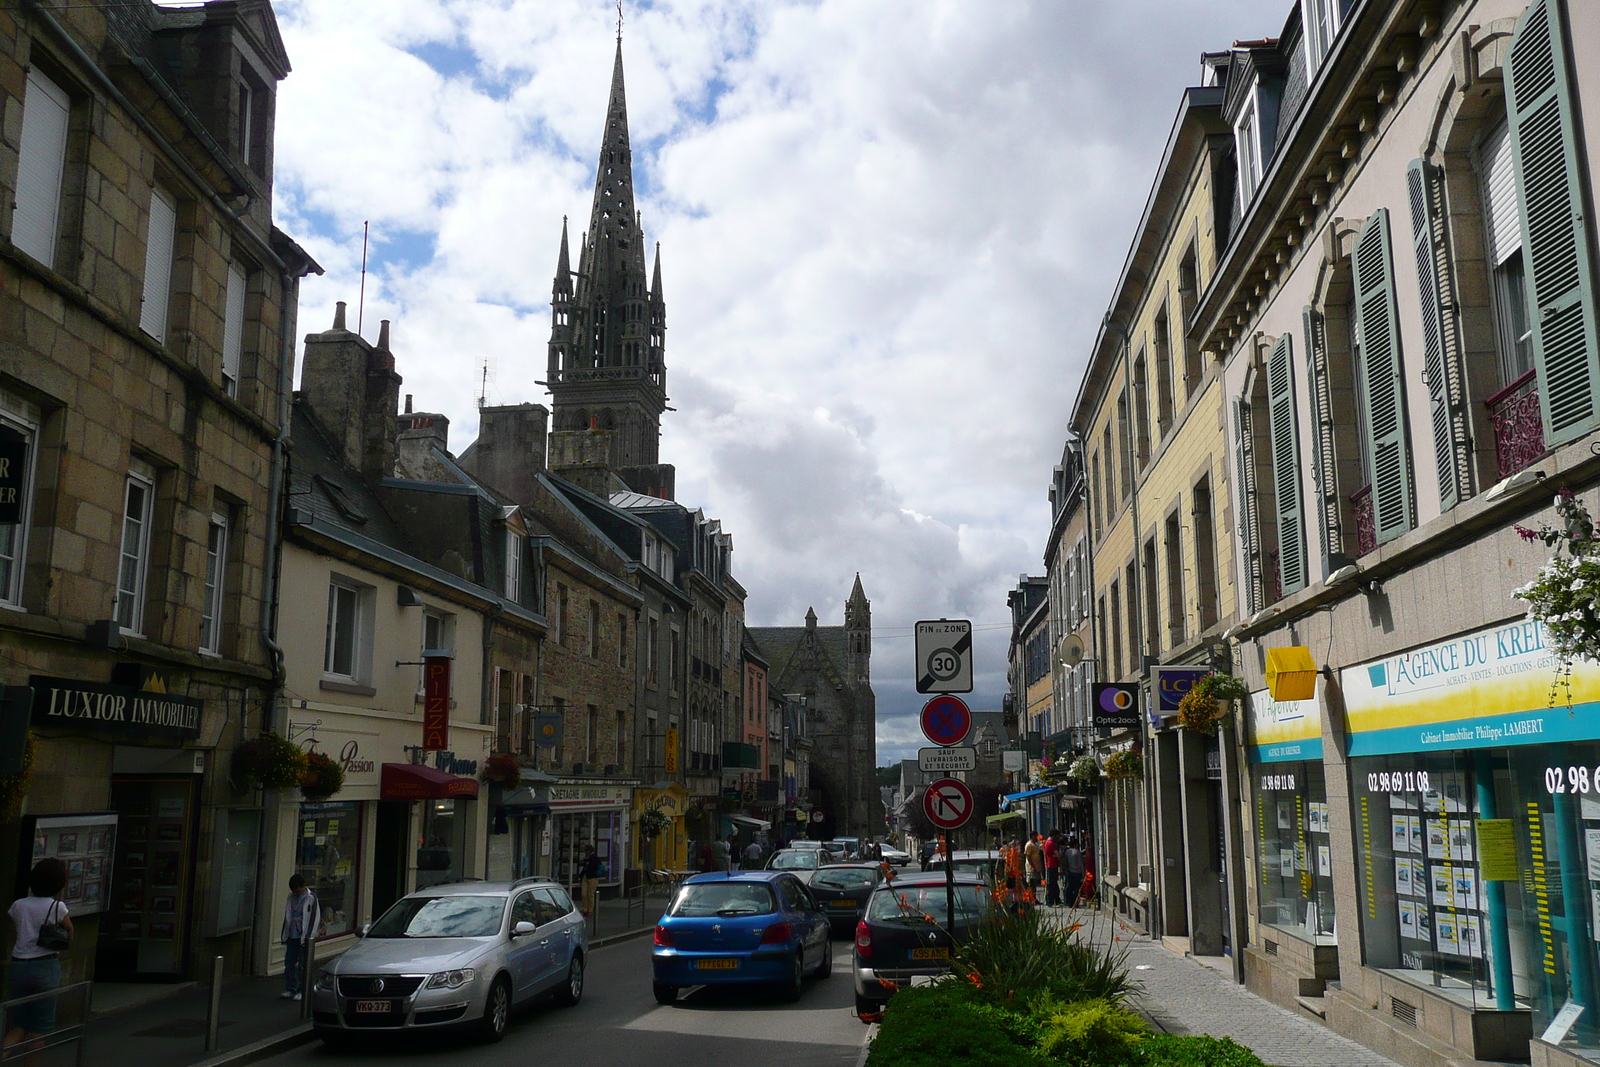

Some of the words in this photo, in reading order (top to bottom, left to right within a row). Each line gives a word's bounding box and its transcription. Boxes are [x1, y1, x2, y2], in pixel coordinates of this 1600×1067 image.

[919, 625, 934, 633] FIN
[944, 625, 967, 633] ZONE
[1462, 635, 1488, 667] DU
[933, 657, 955, 672] 30
[1496, 660, 1532, 676] LOCATIONS
[47, 688, 126, 722] LUXIOR
[131, 698, 199, 730] IMMOBILIER
[427, 664, 445, 746] PIZZA
[1095, 716, 1117, 726] Optic
[1117, 716, 1137, 724] 2000
[1420, 731, 1442, 744] Cabinet
[1442, 727, 1474, 742] Immobilier
[1475, 725, 1502, 741] Philippe
[1503, 719, 1544, 737] LAMBERT
[340, 741, 375, 773] Passion
[1367, 772, 1378, 792] 02
[1379, 772, 1390, 792] 98
[1391, 771, 1402, 792] 69
[1404, 771, 1415, 792] 11
[1416, 771, 1429, 792] 08
[1545, 766, 1565, 794] 02
[1568, 765, 1590, 794] 98
